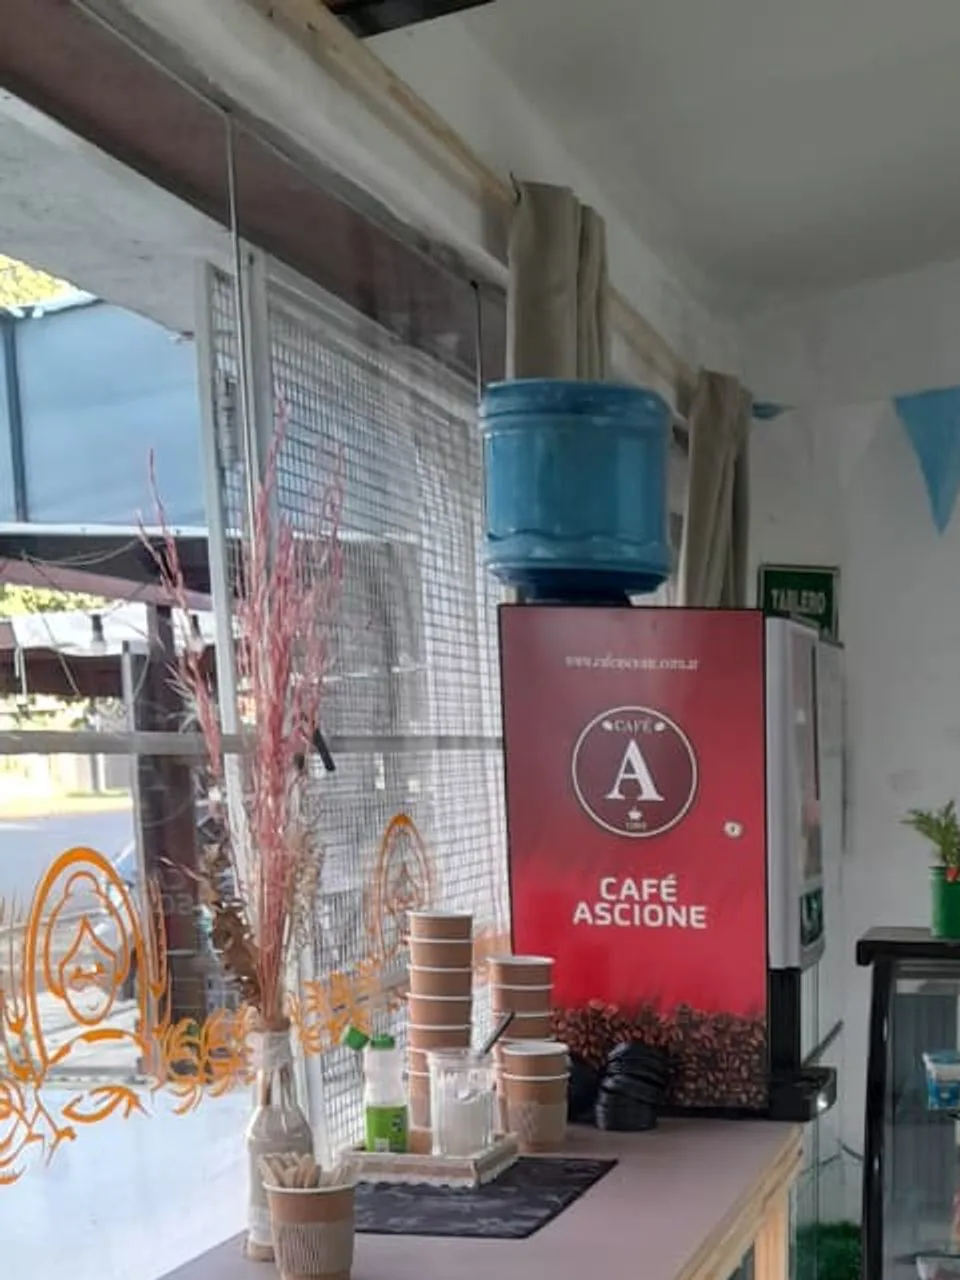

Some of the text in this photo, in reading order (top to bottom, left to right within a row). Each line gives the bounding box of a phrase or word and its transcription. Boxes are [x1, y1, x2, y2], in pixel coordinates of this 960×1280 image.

[605, 740, 665, 801] A
[600, 873, 678, 902] CAFÉ
[573, 901, 707, 928] ASCIONE
